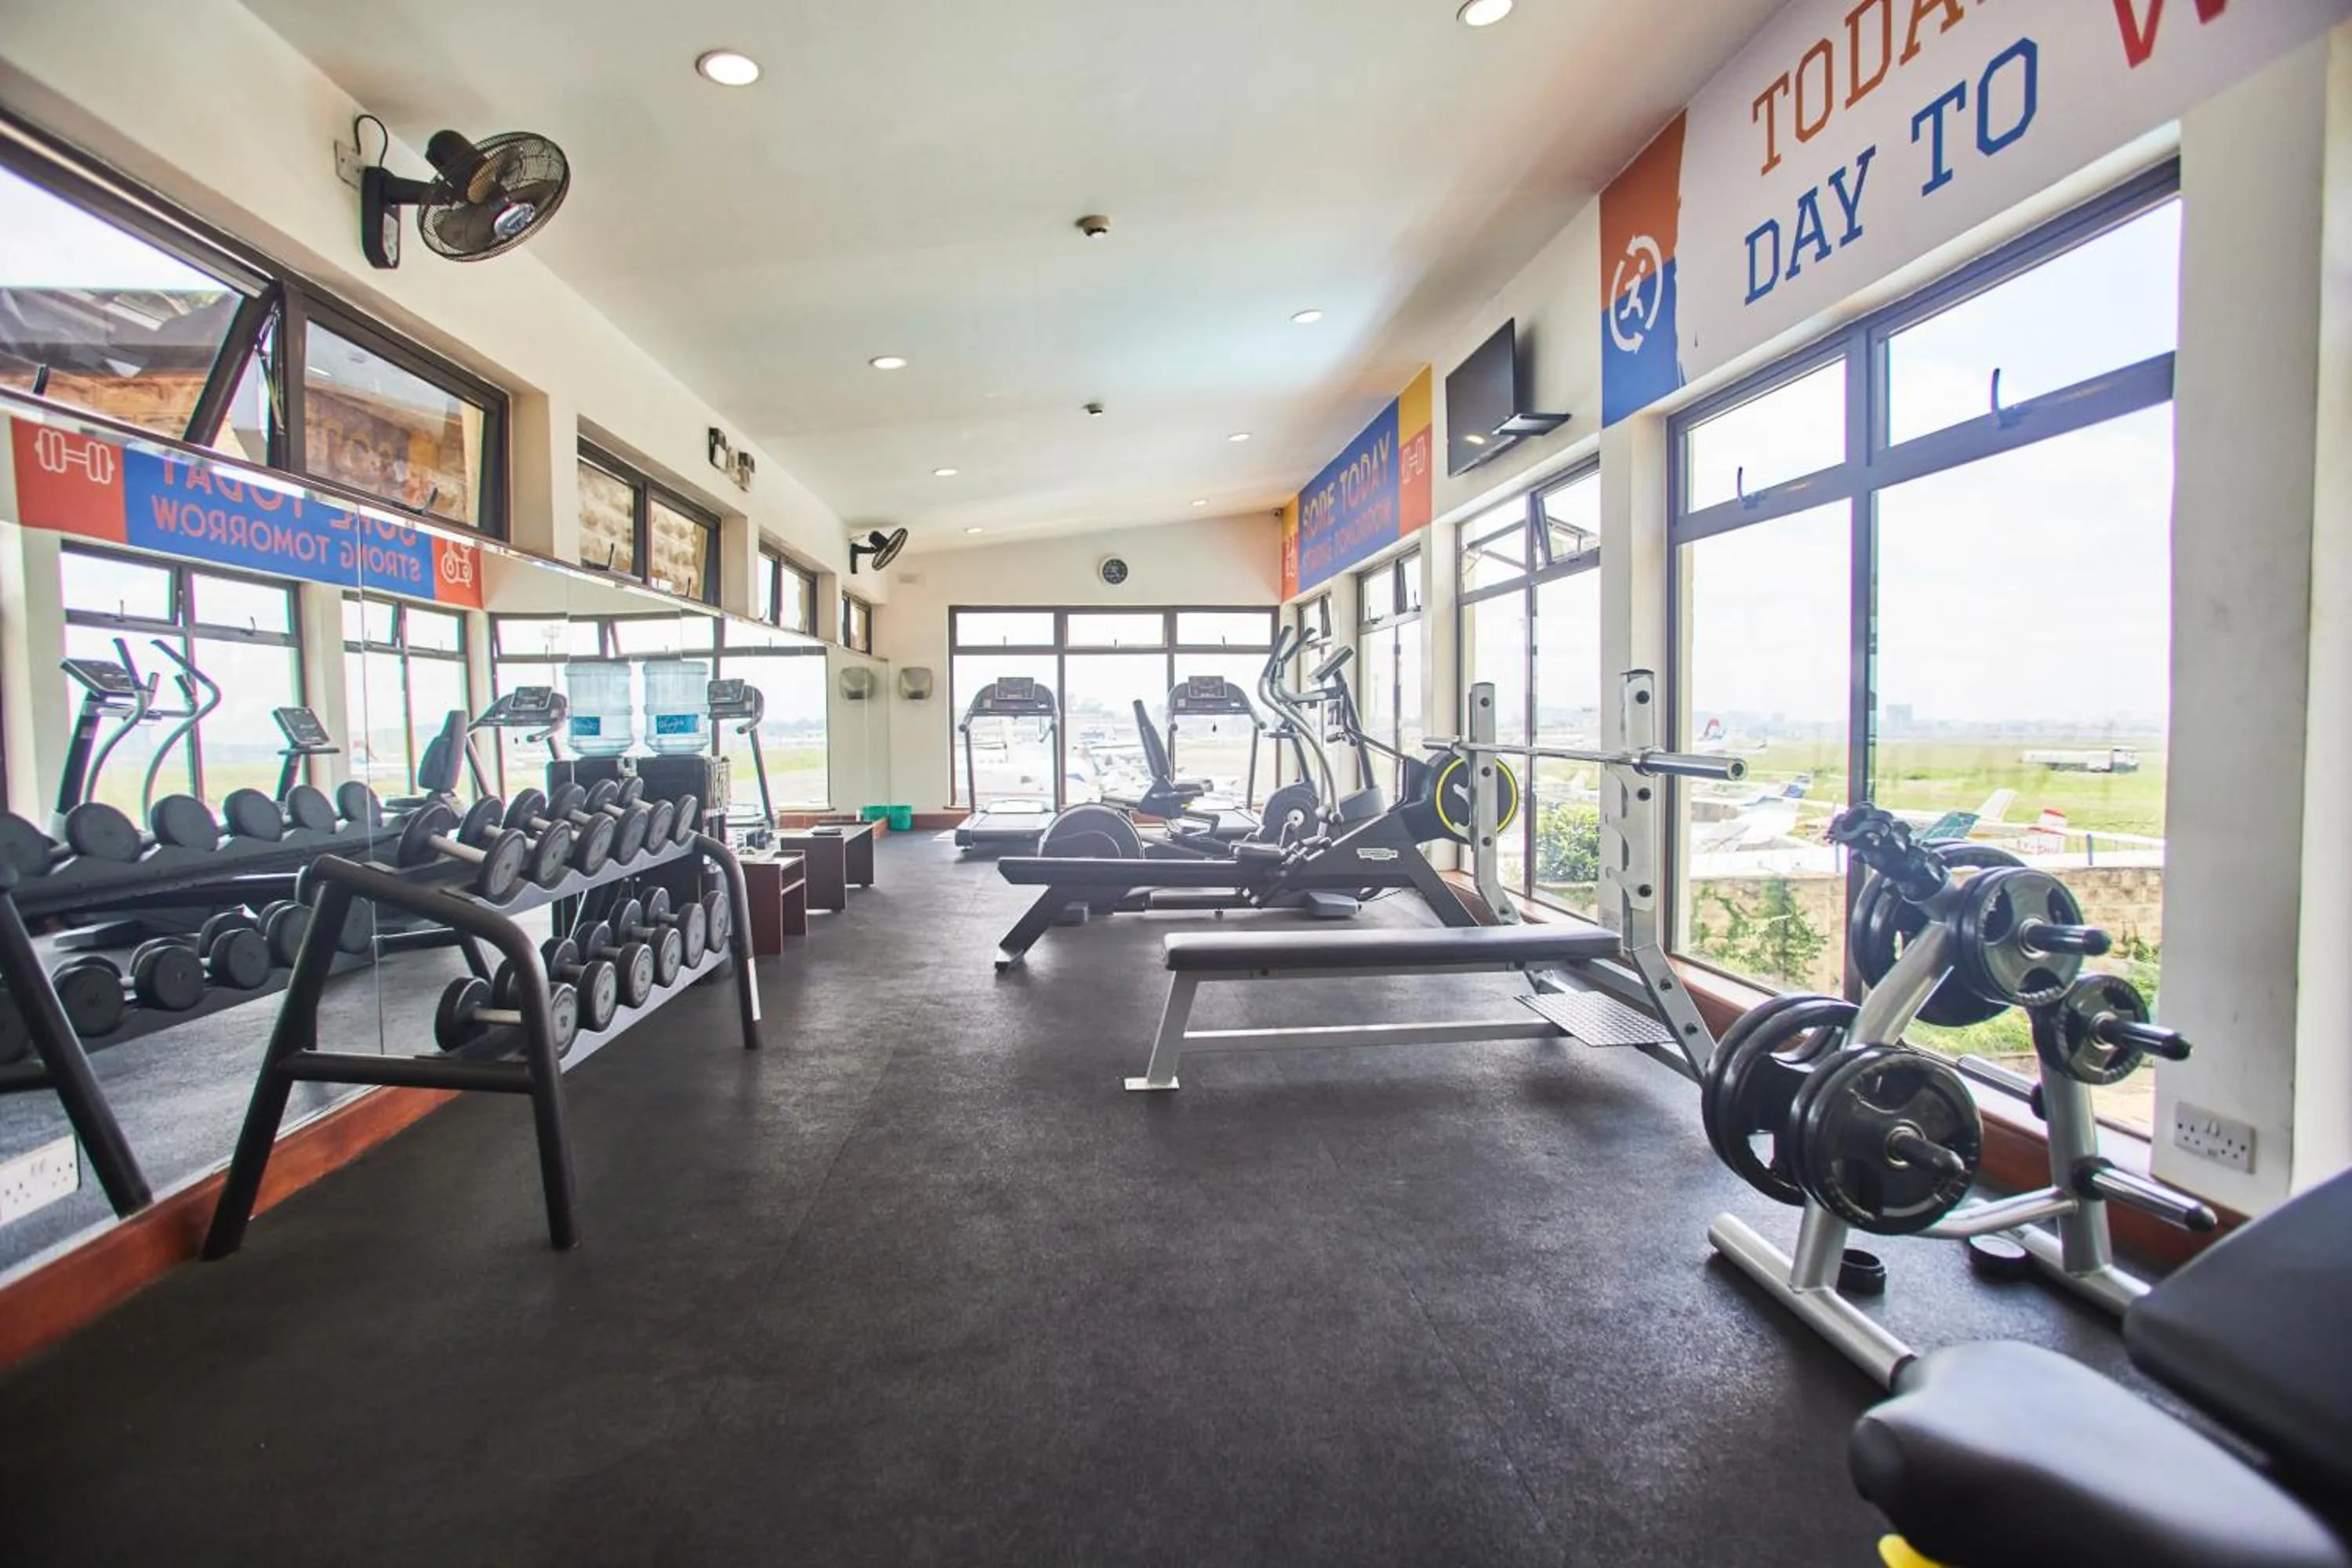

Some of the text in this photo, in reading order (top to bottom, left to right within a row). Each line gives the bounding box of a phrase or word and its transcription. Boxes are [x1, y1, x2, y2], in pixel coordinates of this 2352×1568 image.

[1744, 37, 2038, 307] DAY TO
[1752, 0, 1984, 177] TODA
[1340, 430, 1391, 515] TODAY
